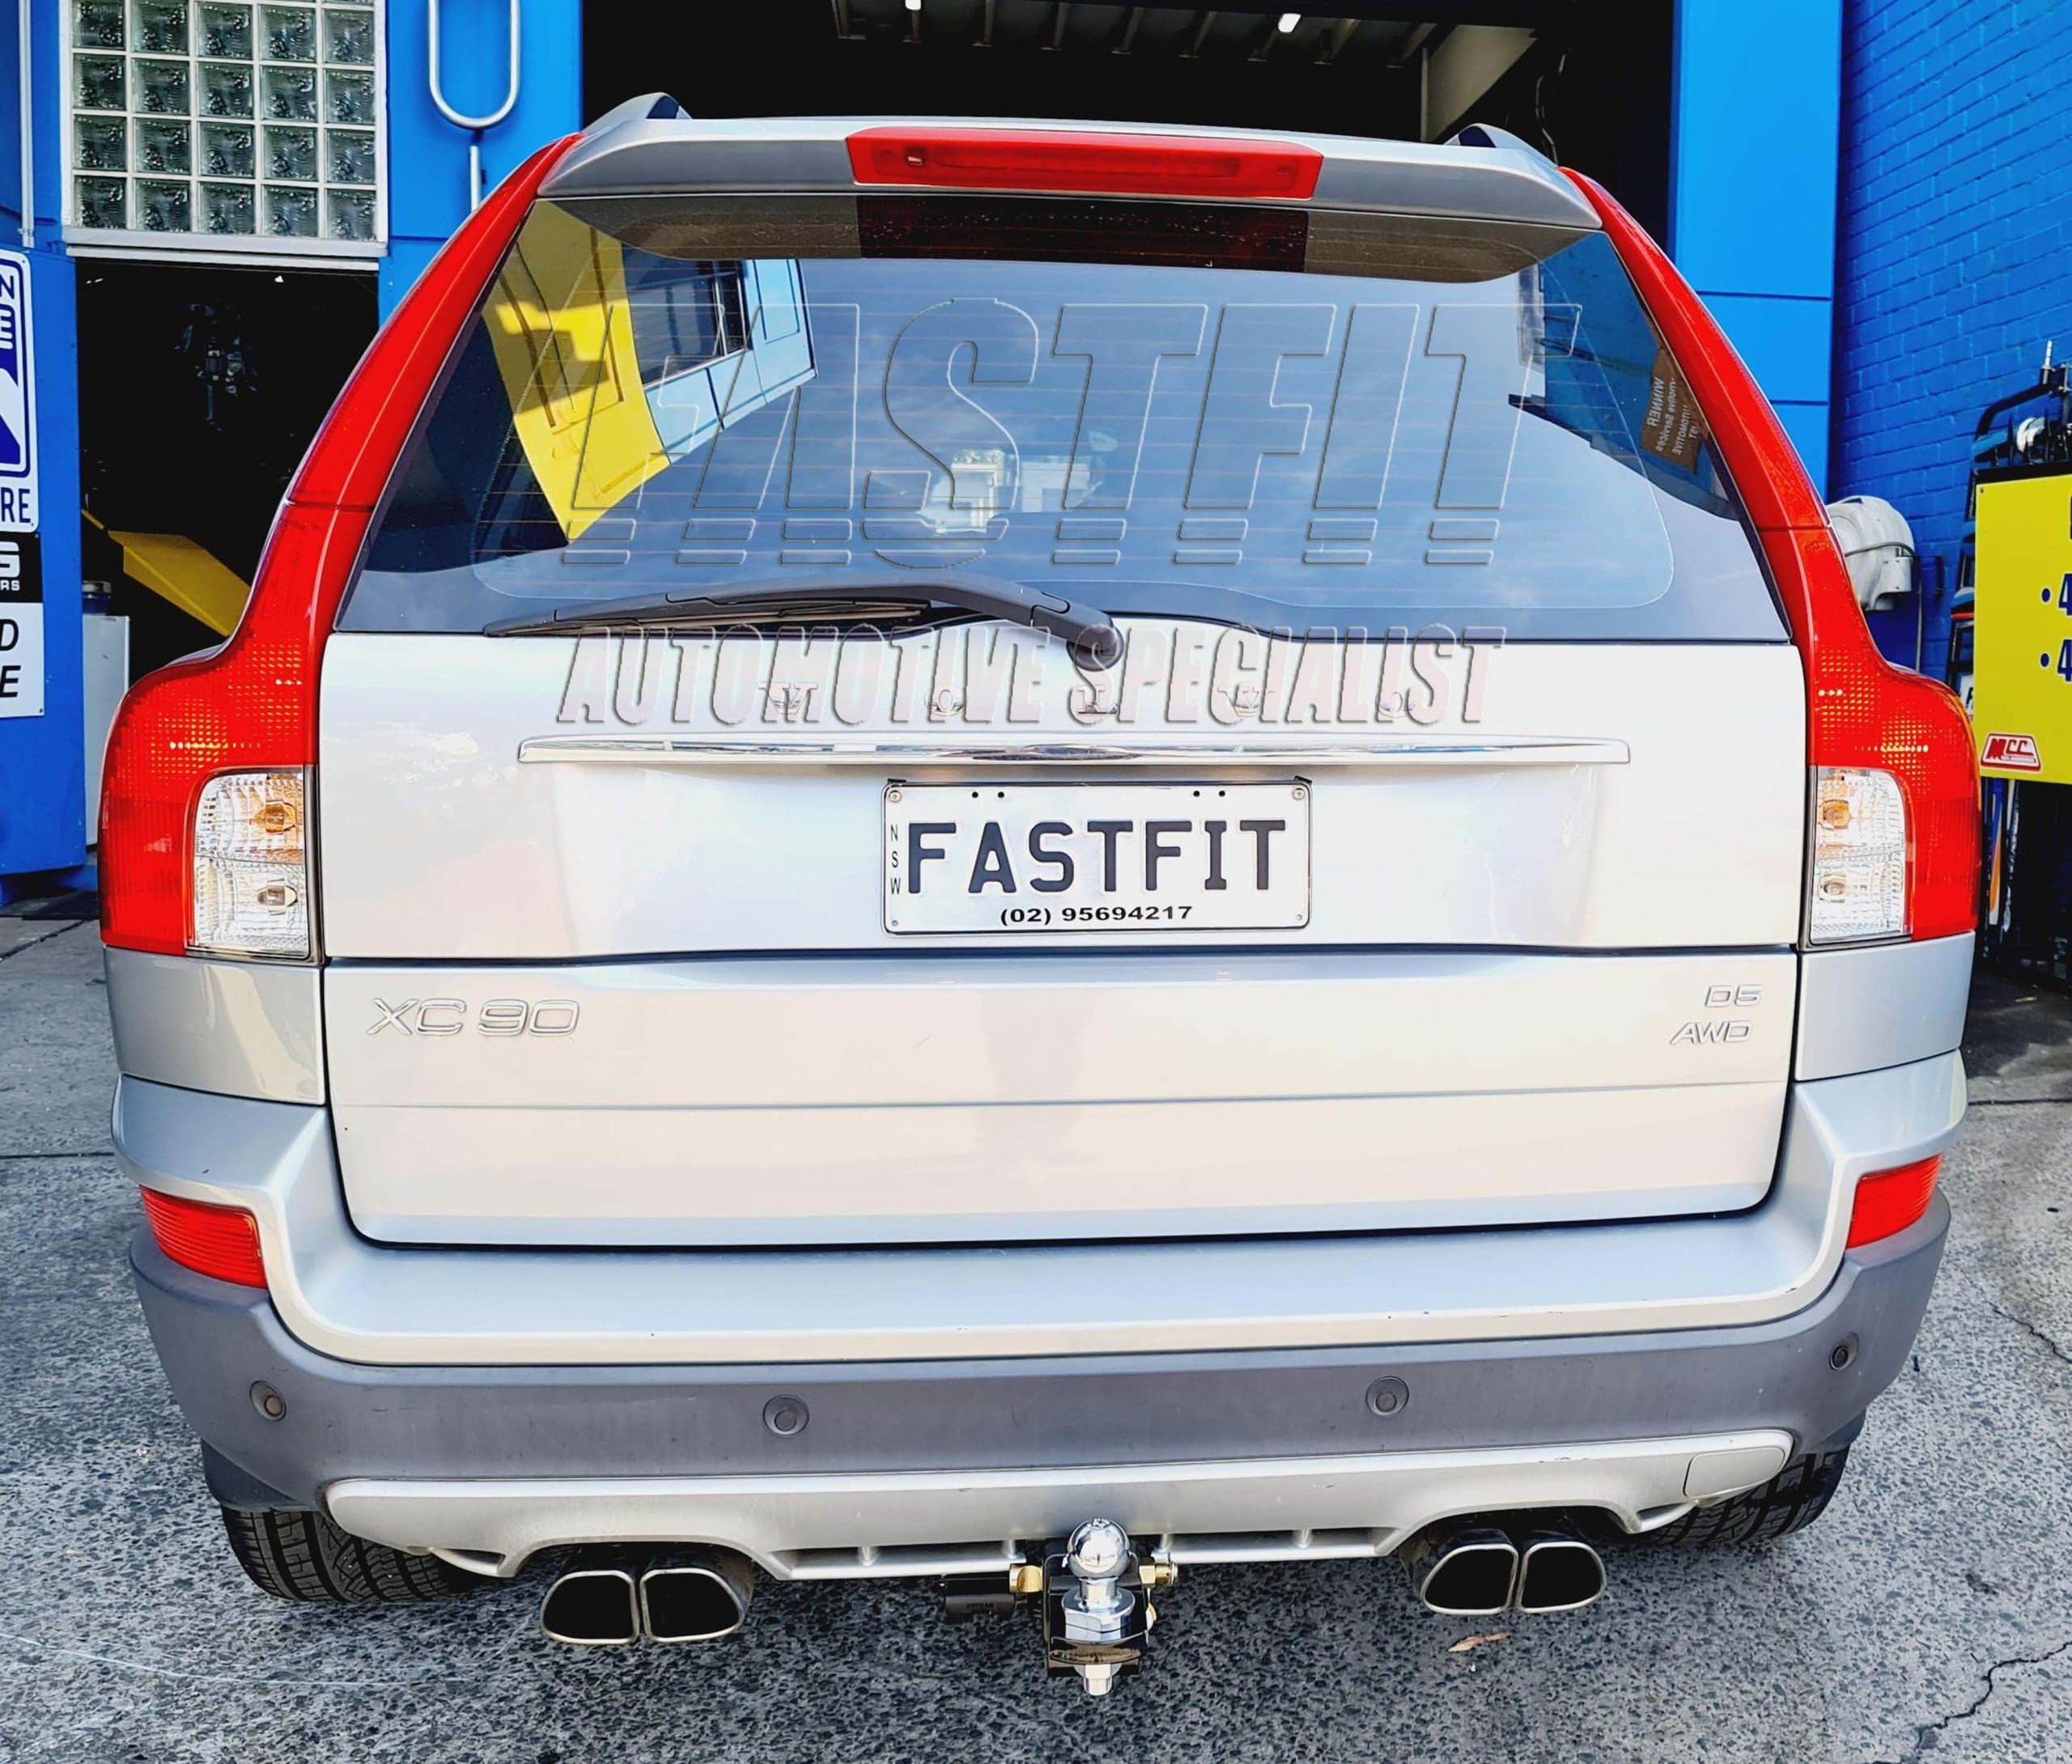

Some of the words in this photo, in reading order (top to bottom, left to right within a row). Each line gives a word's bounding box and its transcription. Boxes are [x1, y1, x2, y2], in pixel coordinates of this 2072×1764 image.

[890, 824, 901, 895] NSW
[907, 820, 1286, 894] FASTFIT
[1000, 907, 1052, 926] (02)
[1061, 905, 1193, 922] 95694217
[1704, 984, 1763, 1008] D5
[366, 997, 467, 1037] XC
[478, 998, 580, 1037] 90
[1669, 1020, 1753, 1046] AWD
